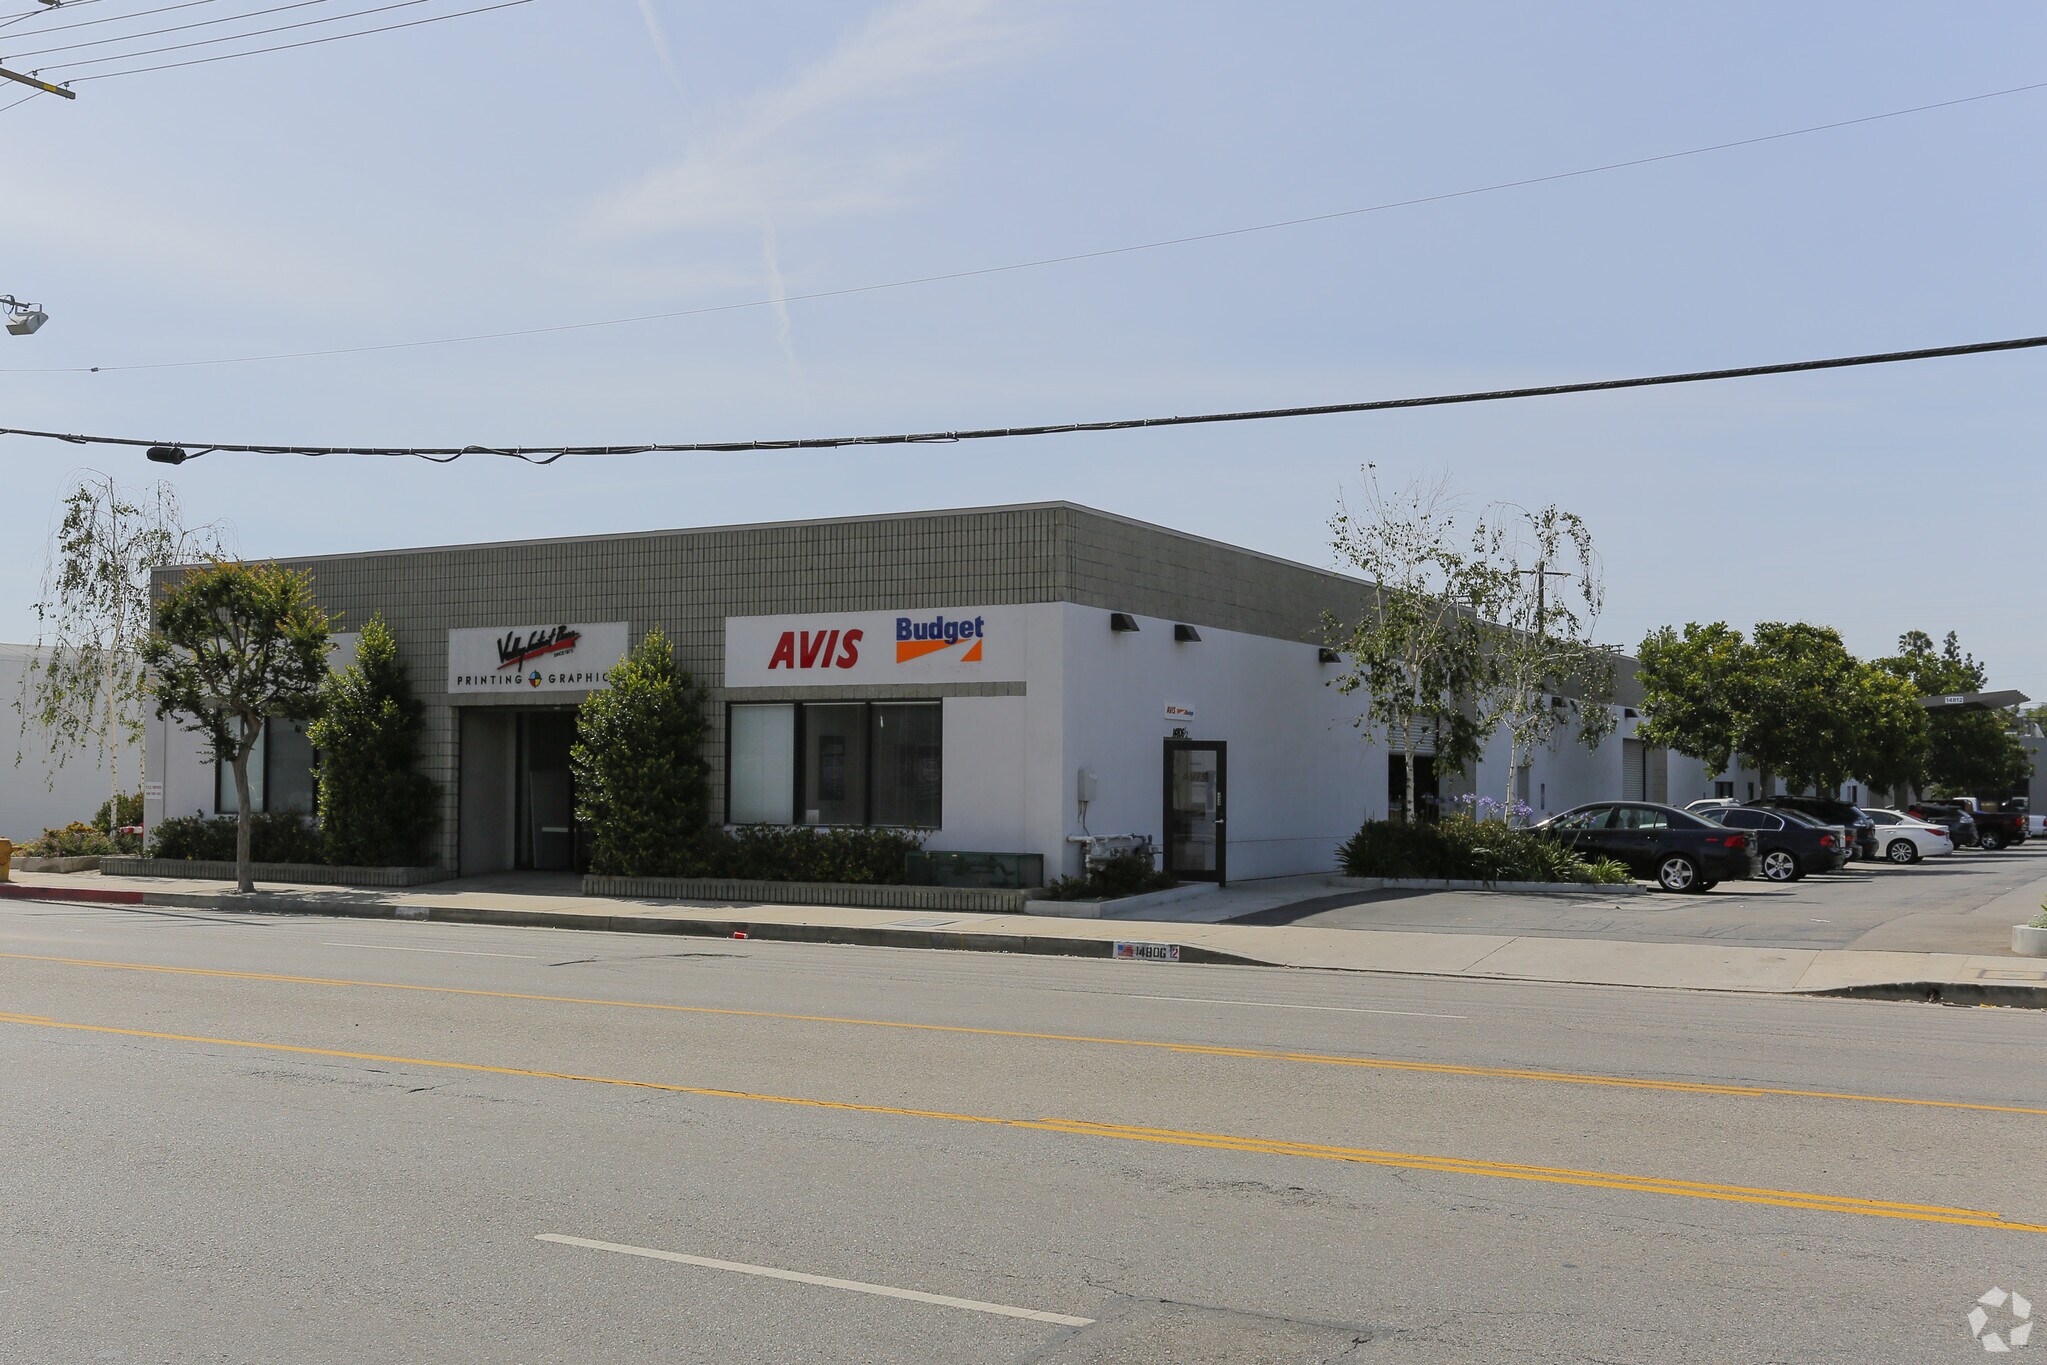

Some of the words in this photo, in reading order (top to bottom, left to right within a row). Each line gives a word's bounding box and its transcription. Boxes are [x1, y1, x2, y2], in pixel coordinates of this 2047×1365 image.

[896, 615, 985, 645] Budget
[767, 628, 864, 670] AVIS
[457, 674, 523, 686] PRINTING
